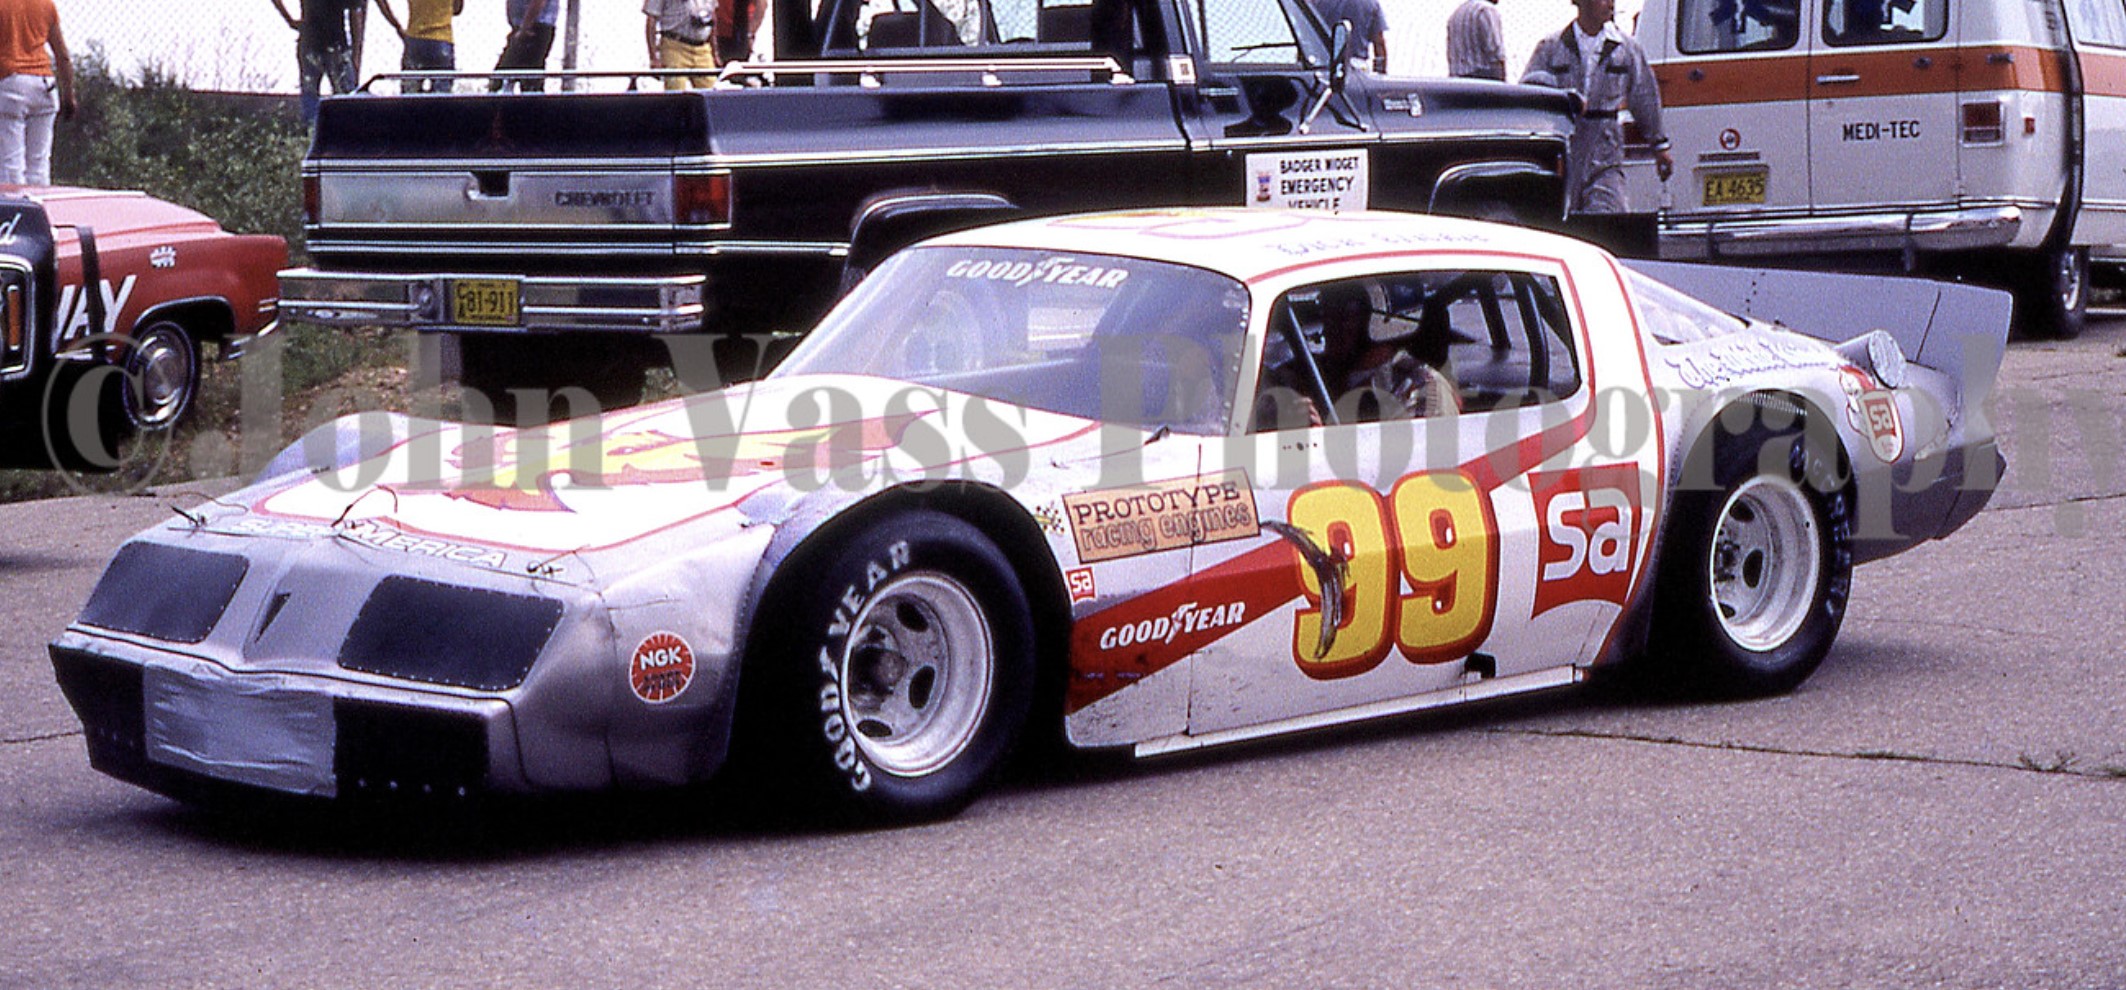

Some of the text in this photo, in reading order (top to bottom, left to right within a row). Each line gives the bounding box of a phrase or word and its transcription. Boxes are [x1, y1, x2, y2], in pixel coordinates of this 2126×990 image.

[1842, 120, 1921, 141] MEDI-TEC
[1280, 158, 1322, 174] BADGER
[1281, 176, 1355, 195] EMERGENCY
[946, 256, 1130, 288] GOODYEAR
[467, 290, 514, 313] 81-911
[1869, 404, 1893, 432] sa
[1073, 481, 1241, 525] PROTOTYPE
[1081, 501, 1251, 551] racing engines
[1542, 487, 1633, 581] sa
[1070, 571, 1093, 593] sa
[1286, 469, 1501, 681] 99
[1100, 601, 1247, 651] GOODYEAR
[640, 645, 683, 671] NGK
